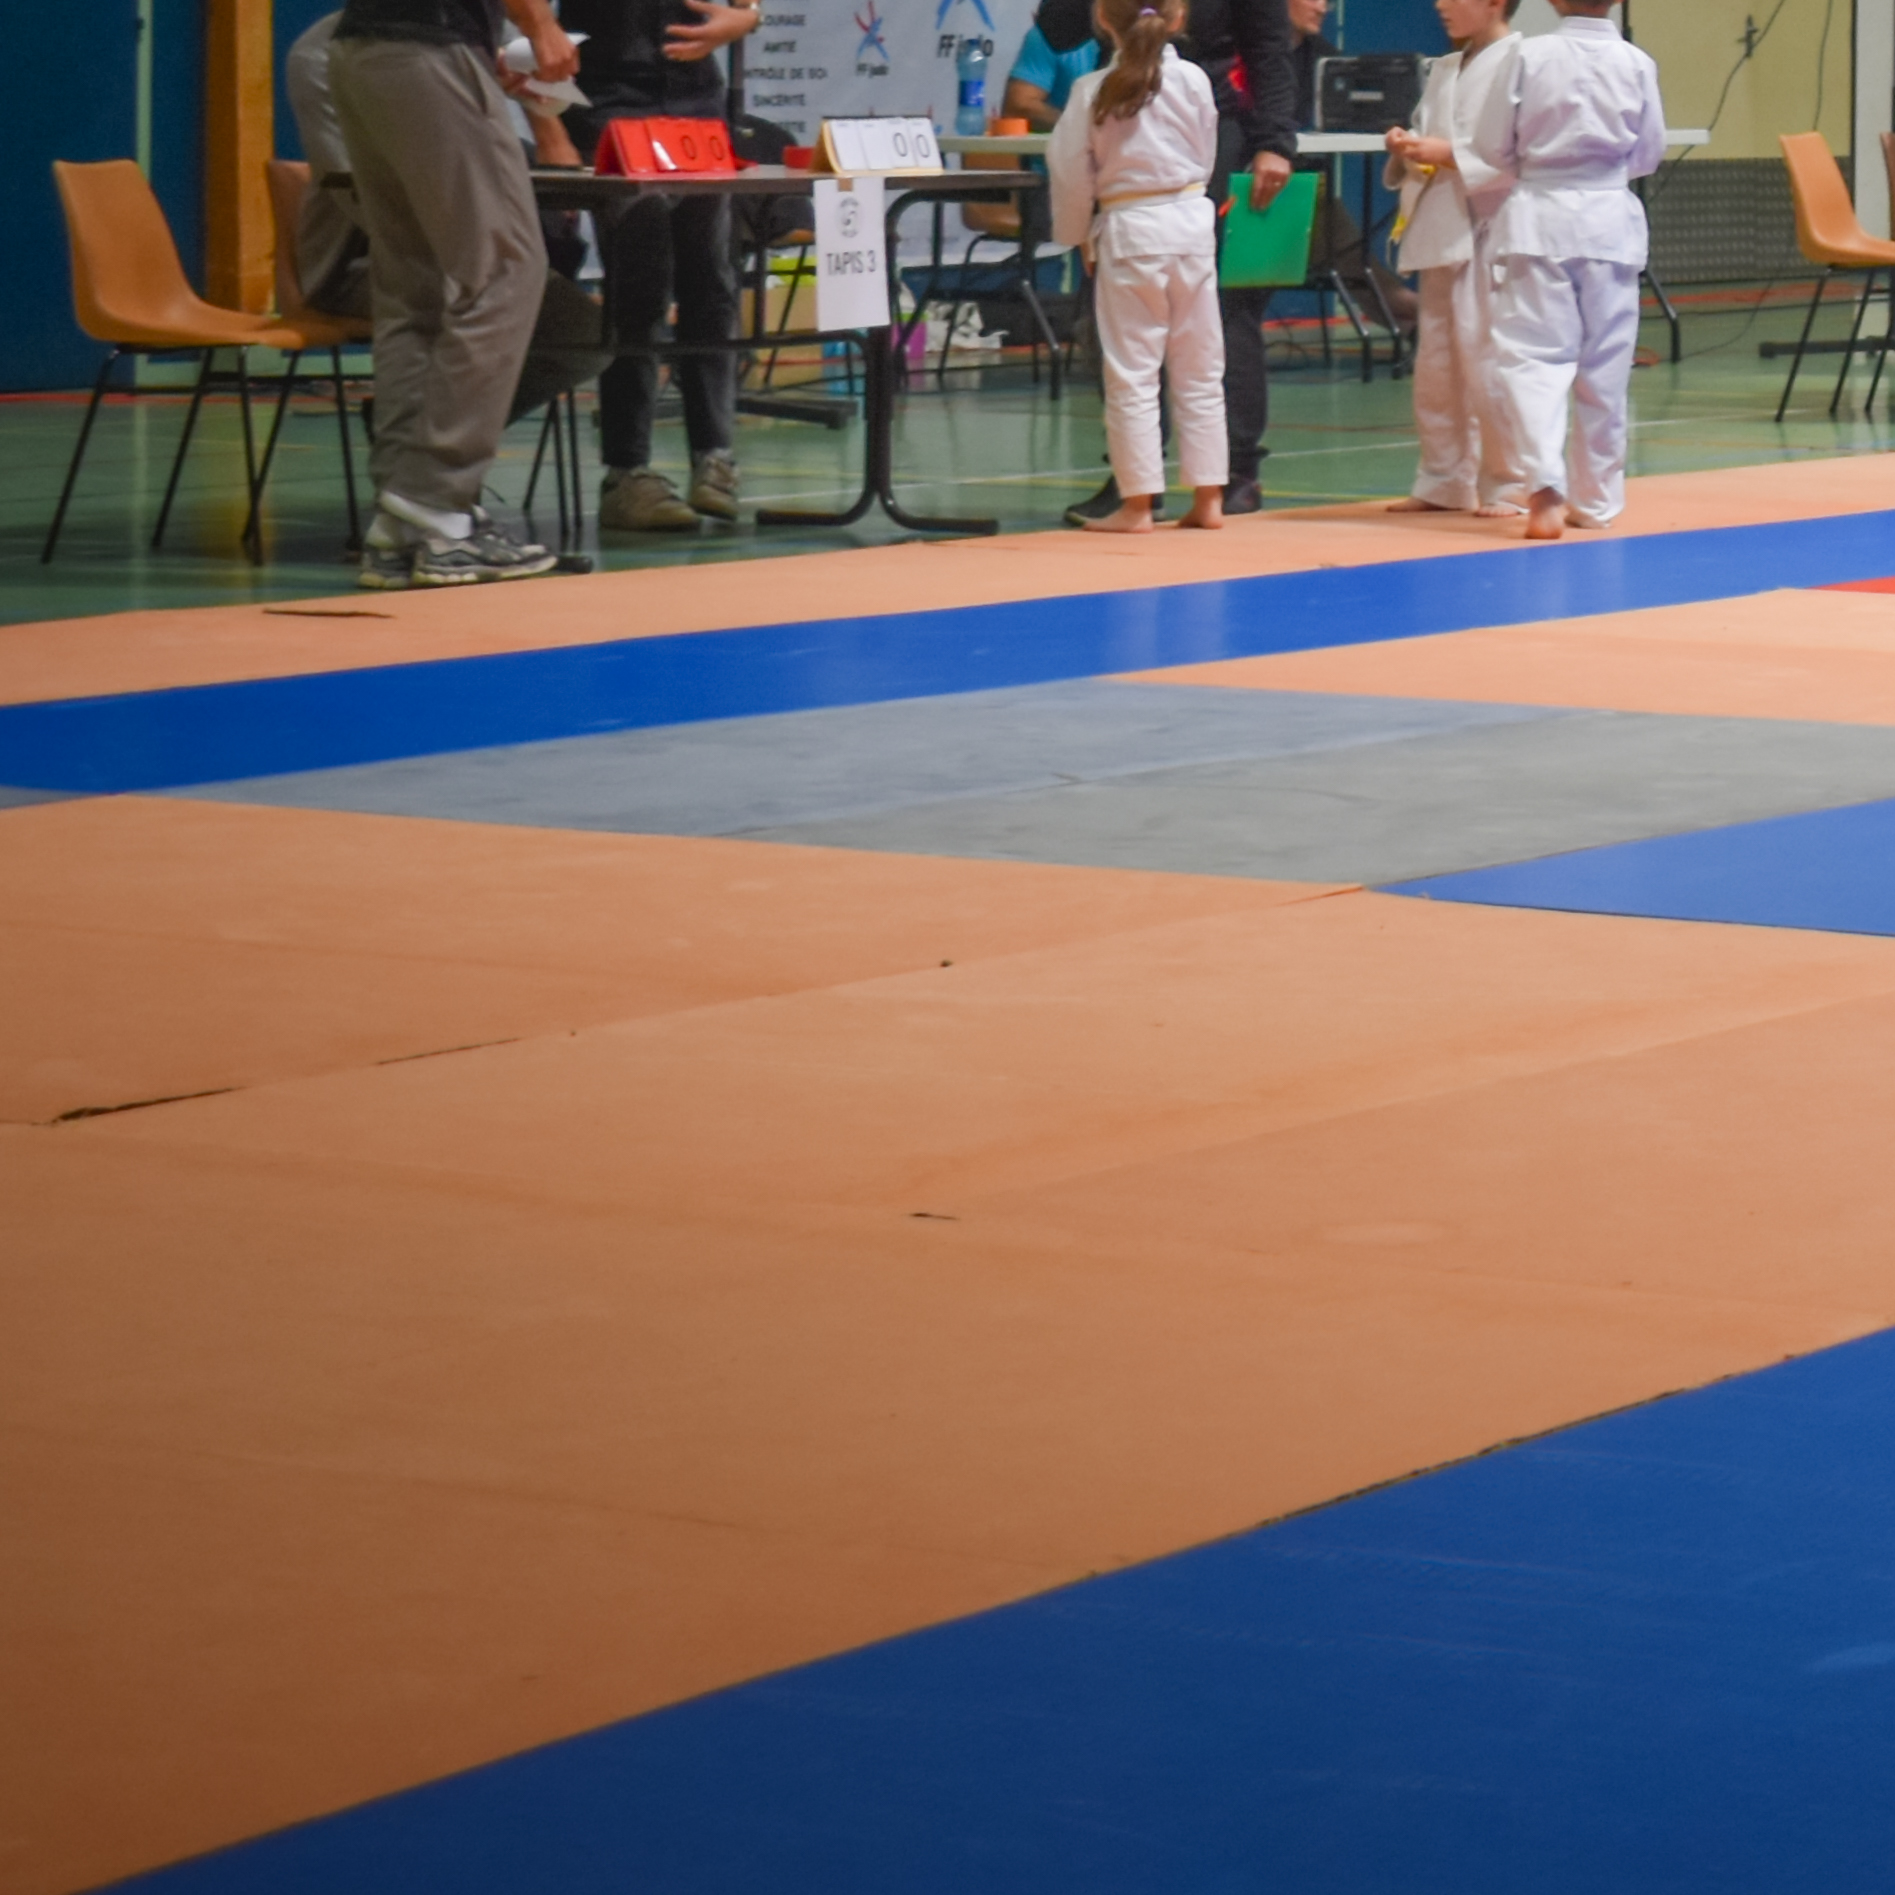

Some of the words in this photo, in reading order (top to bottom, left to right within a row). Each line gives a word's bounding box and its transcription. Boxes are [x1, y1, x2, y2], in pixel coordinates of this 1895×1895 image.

[764, 14, 806, 26] OURAGE
[938, 35, 955, 57] FF
[681, 134, 698, 161] 0
[709, 134, 725, 161] 0
[893, 132, 908, 157] 0
[916, 134, 930, 158] 0
[826, 250, 864, 275] TAPIS
[867, 249, 877, 272] 3
